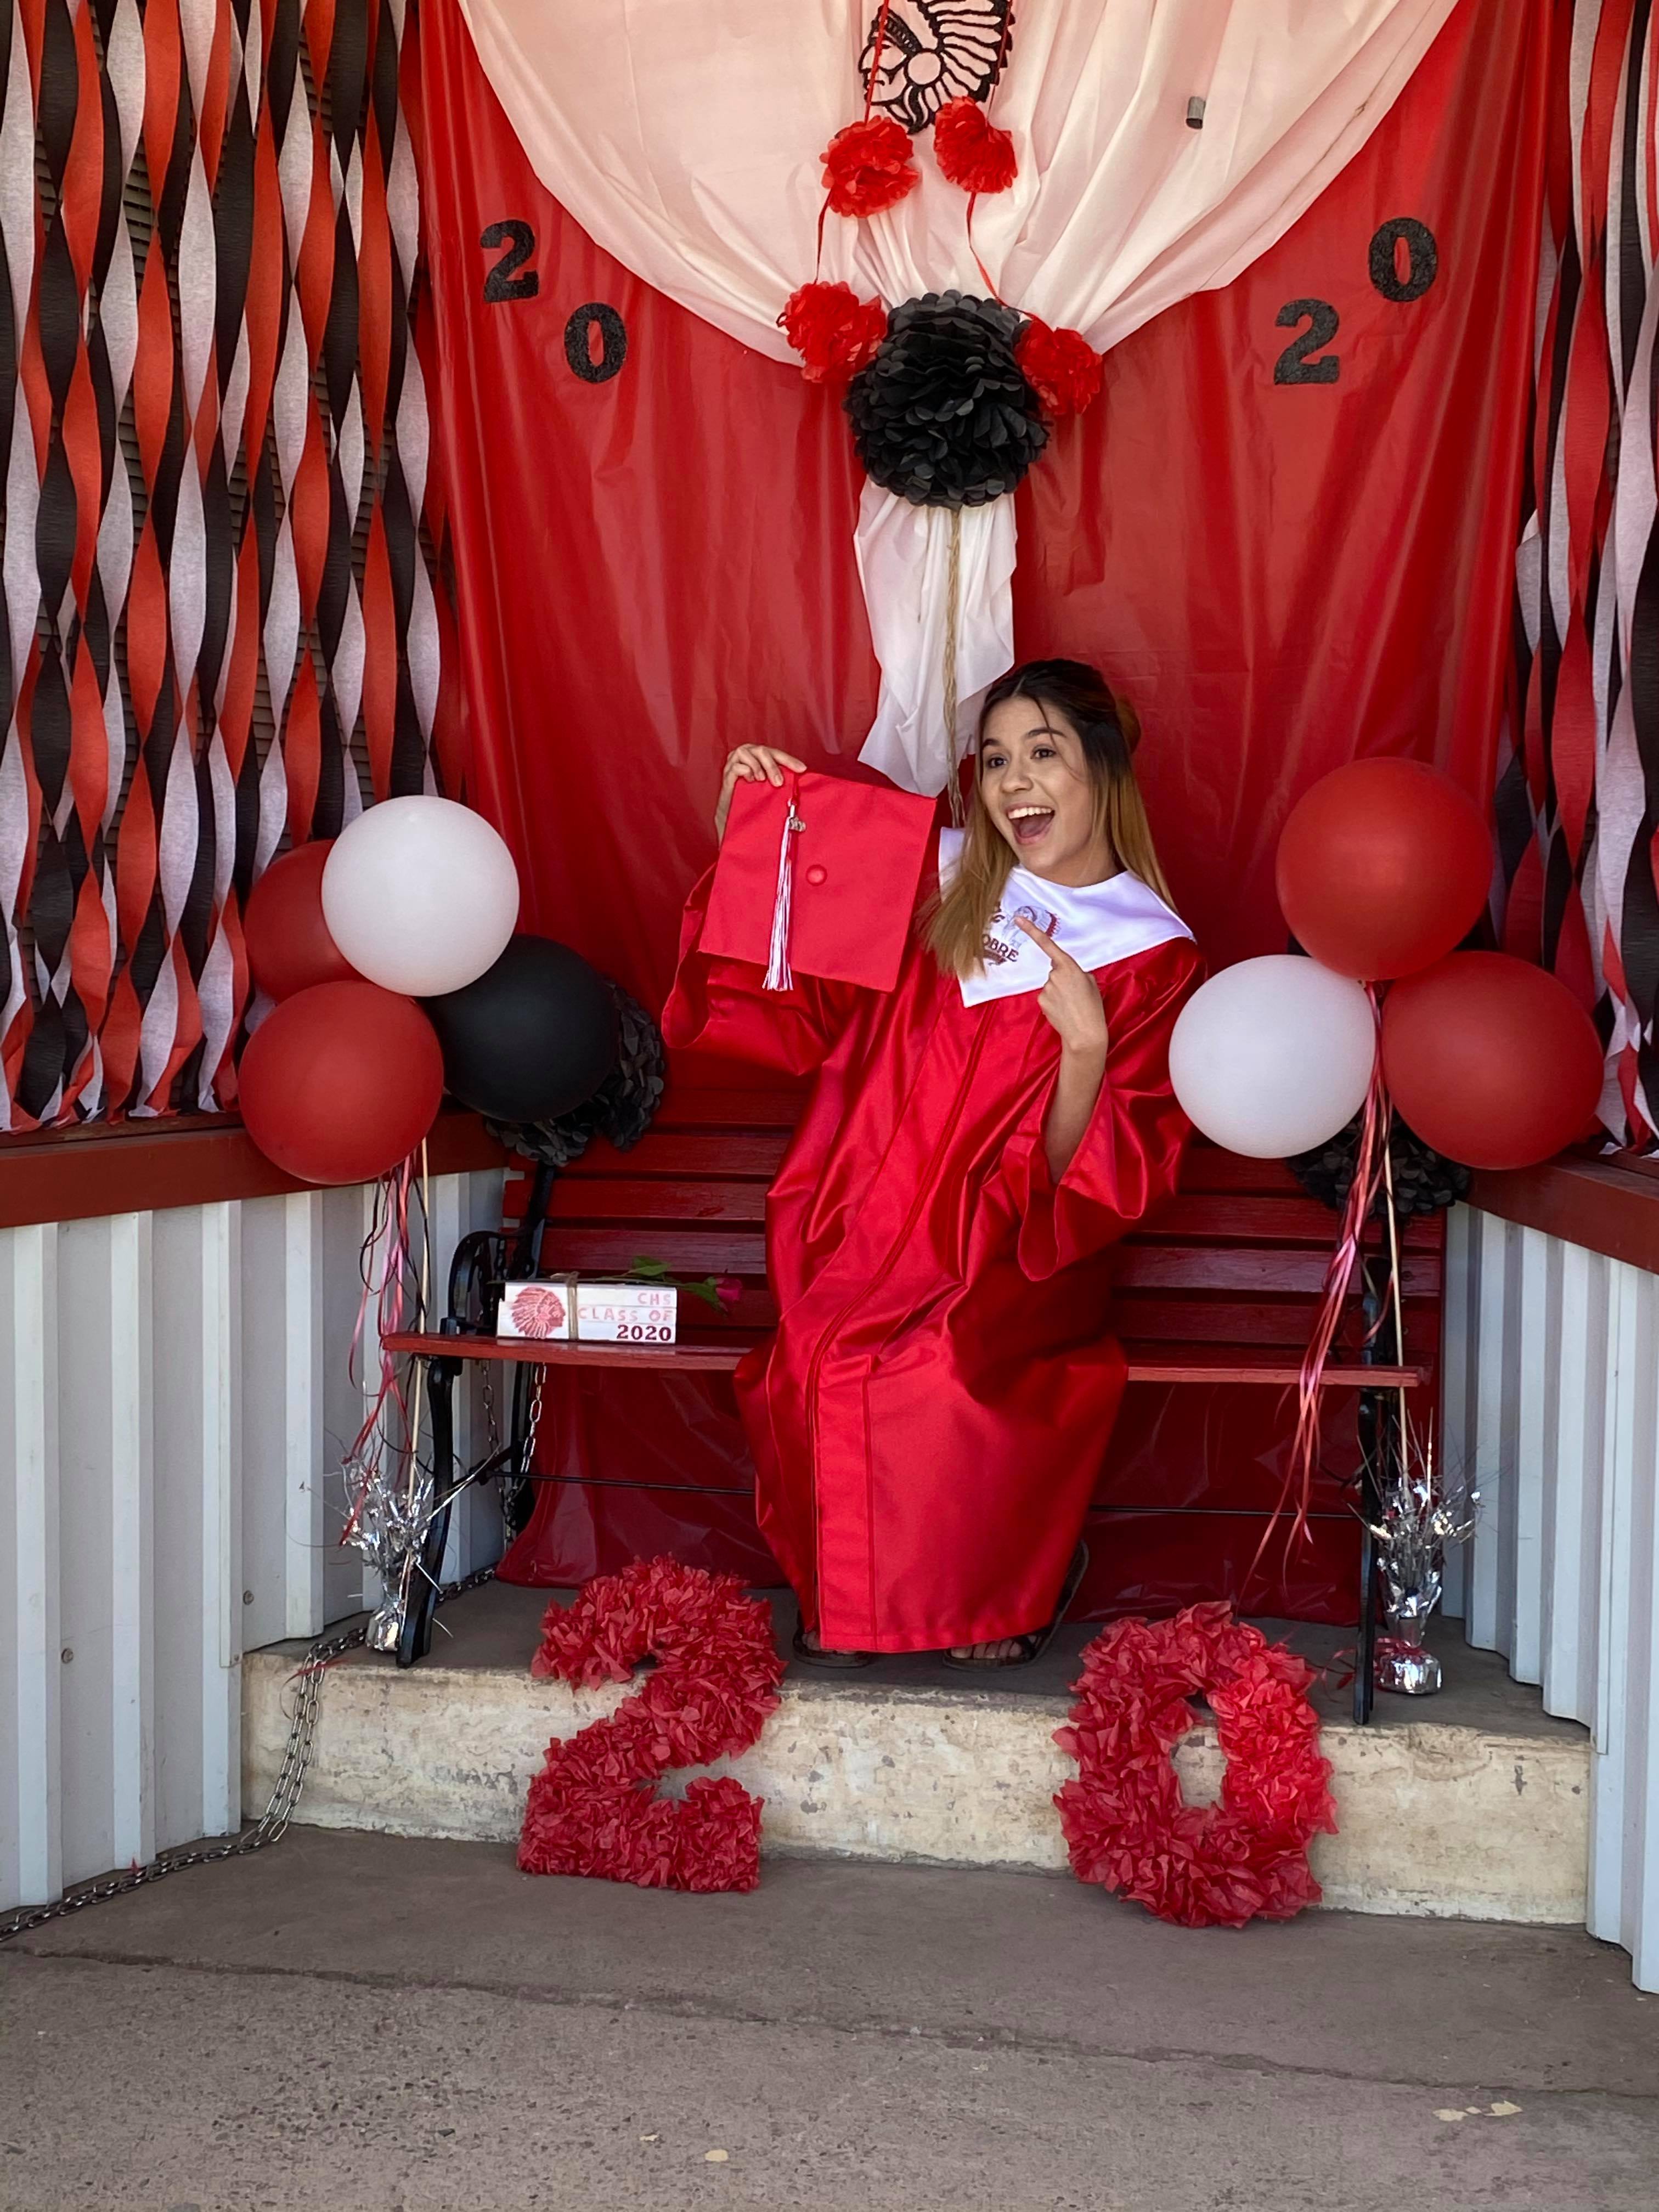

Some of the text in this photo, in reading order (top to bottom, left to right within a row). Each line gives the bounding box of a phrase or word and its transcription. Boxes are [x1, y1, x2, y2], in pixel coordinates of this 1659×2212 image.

[480, 219, 539, 302] 2
[1274, 298, 1340, 385] 2
[981, 933, 1019, 962] OBRE
[638, 1293, 671, 1305] CHS
[578, 1308, 673, 1321] CLASS OF
[617, 1325, 672, 1341] 2020
[517, 1554, 788, 1893] 2
